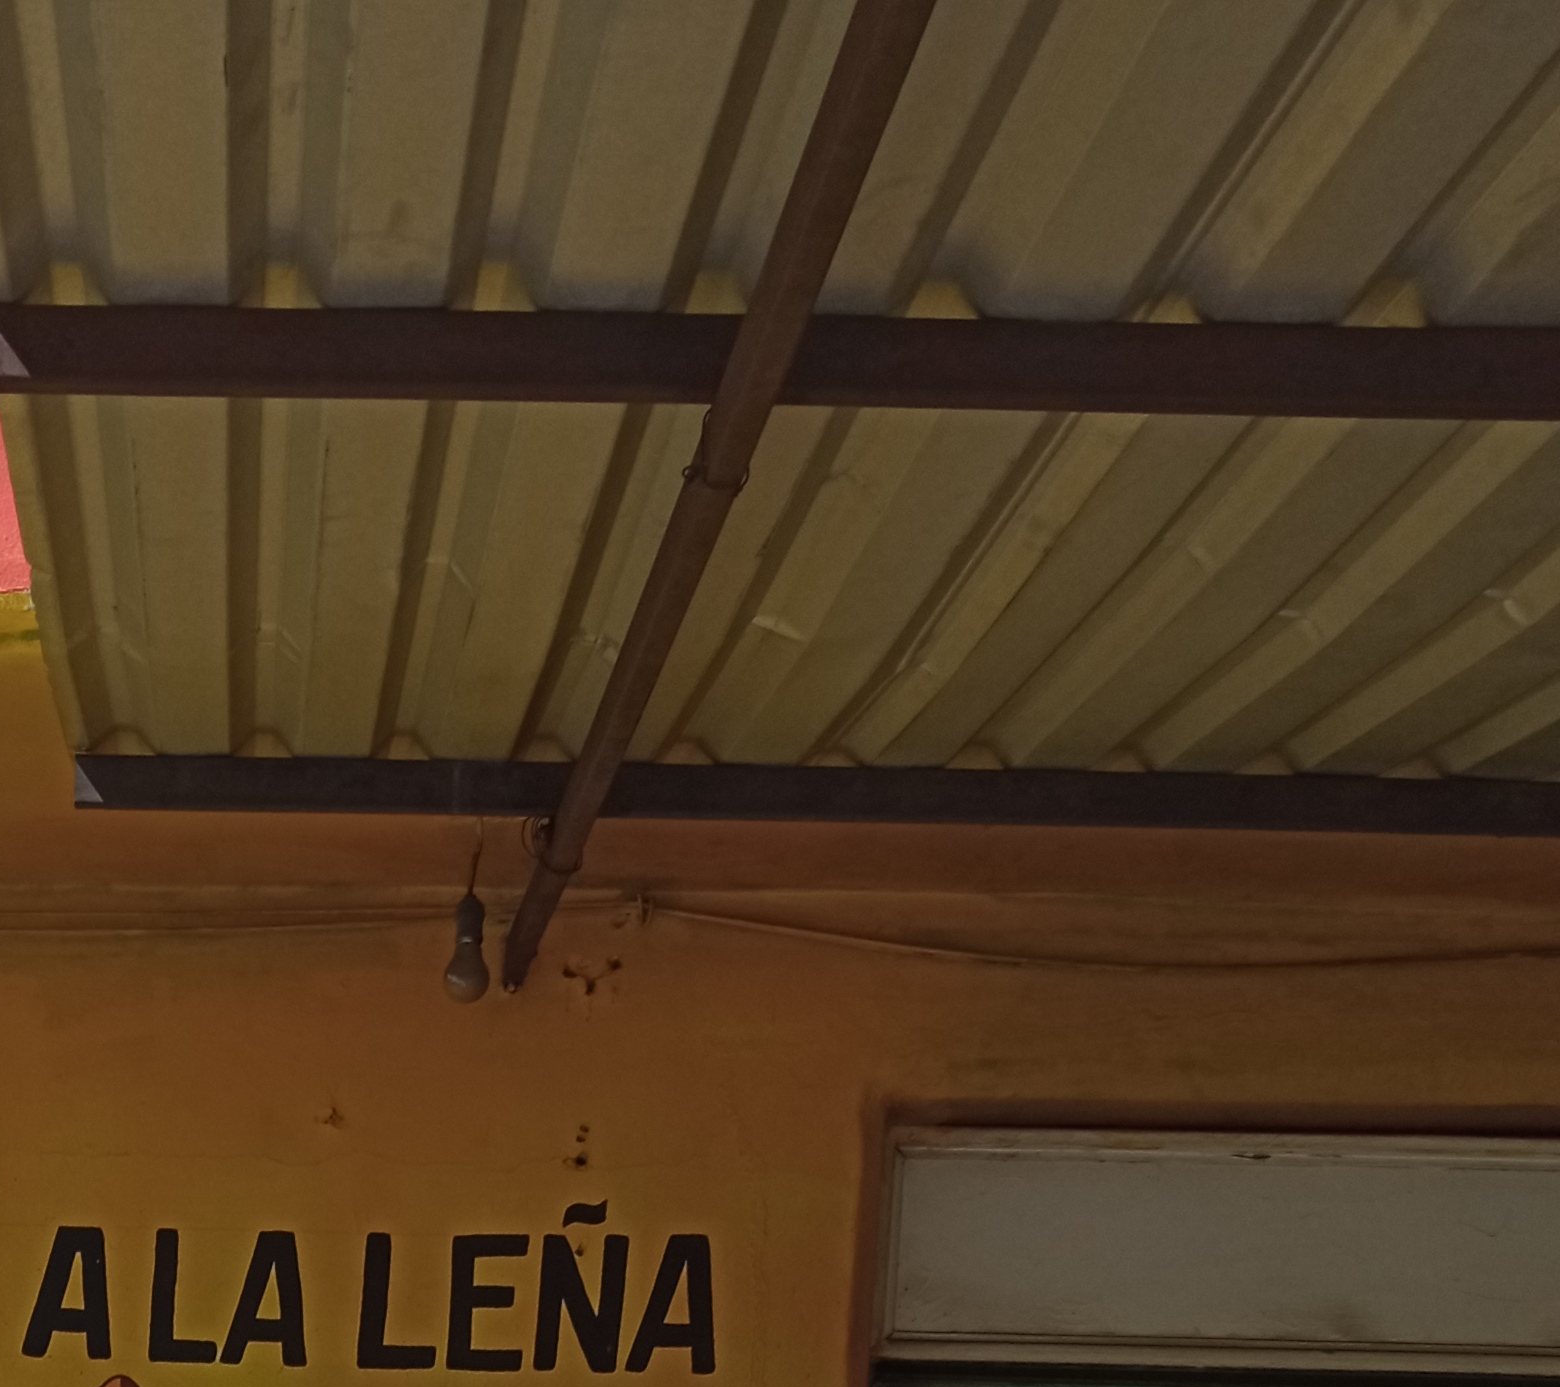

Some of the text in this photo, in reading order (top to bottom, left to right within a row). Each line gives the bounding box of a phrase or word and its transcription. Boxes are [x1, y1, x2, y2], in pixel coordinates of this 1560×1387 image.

[20, 1225, 113, 1360] A
[147, 1227, 309, 1368] LA
[355, 1198, 717, 1376] LEÑA
